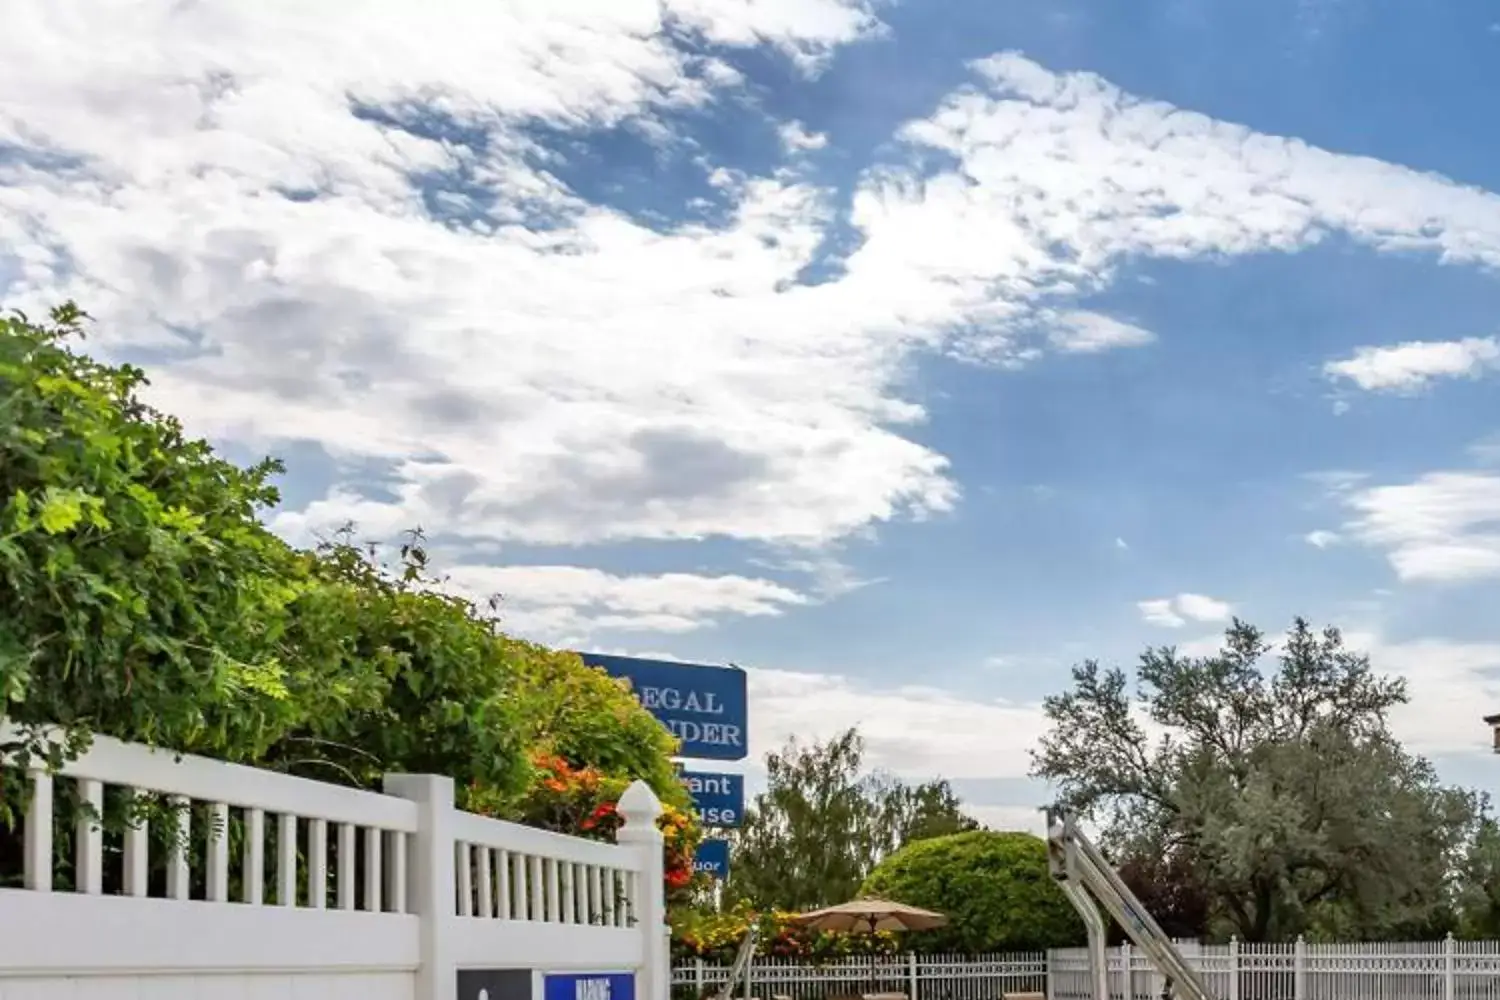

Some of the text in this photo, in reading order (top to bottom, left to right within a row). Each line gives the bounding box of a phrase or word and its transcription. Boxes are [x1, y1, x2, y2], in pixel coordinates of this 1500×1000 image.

[641, 686, 724, 714] EGAL
[687, 776, 732, 795] ant
[693, 861, 721, 871] uor
